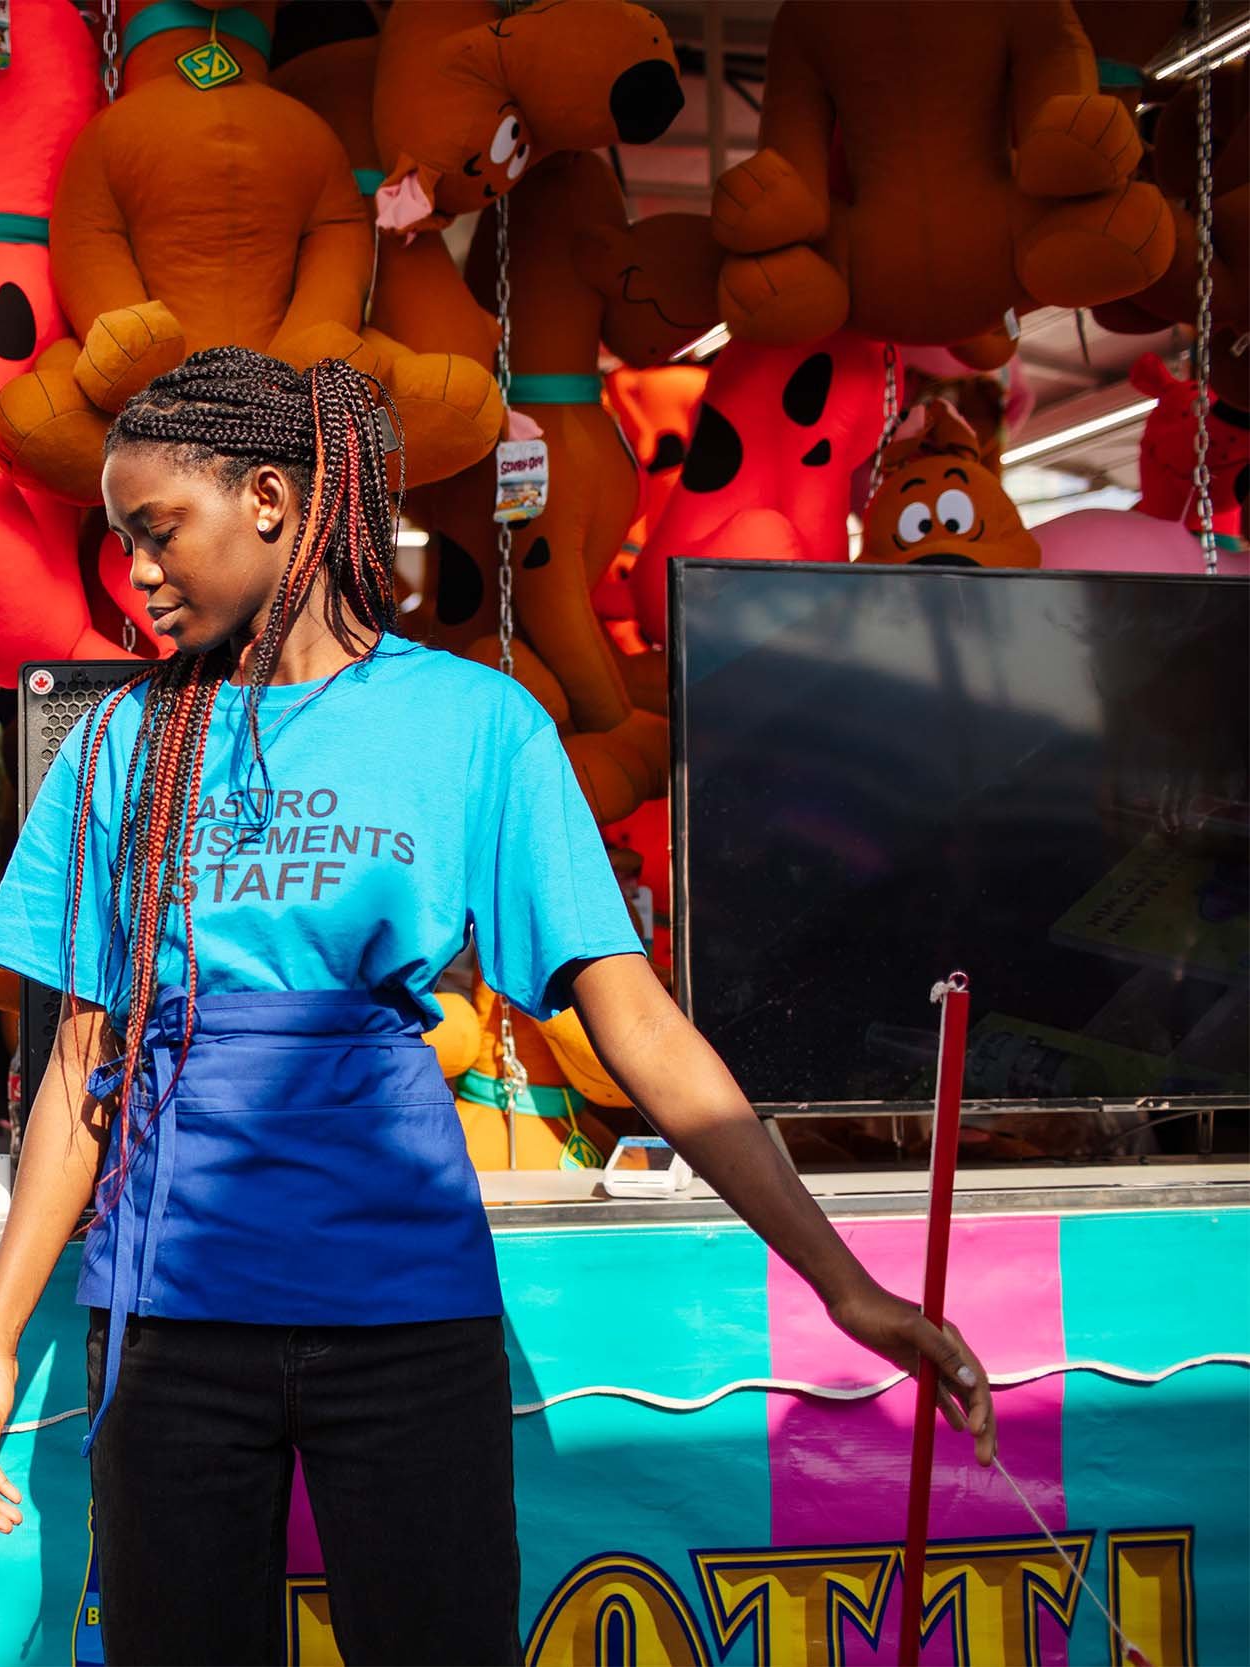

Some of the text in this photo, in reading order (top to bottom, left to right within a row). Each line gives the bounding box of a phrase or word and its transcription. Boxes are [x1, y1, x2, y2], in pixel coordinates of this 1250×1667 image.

[197, 788, 338, 818] ASTRO
[181, 825, 415, 865] USEMENTS
[169, 862, 346, 904] STAFF
